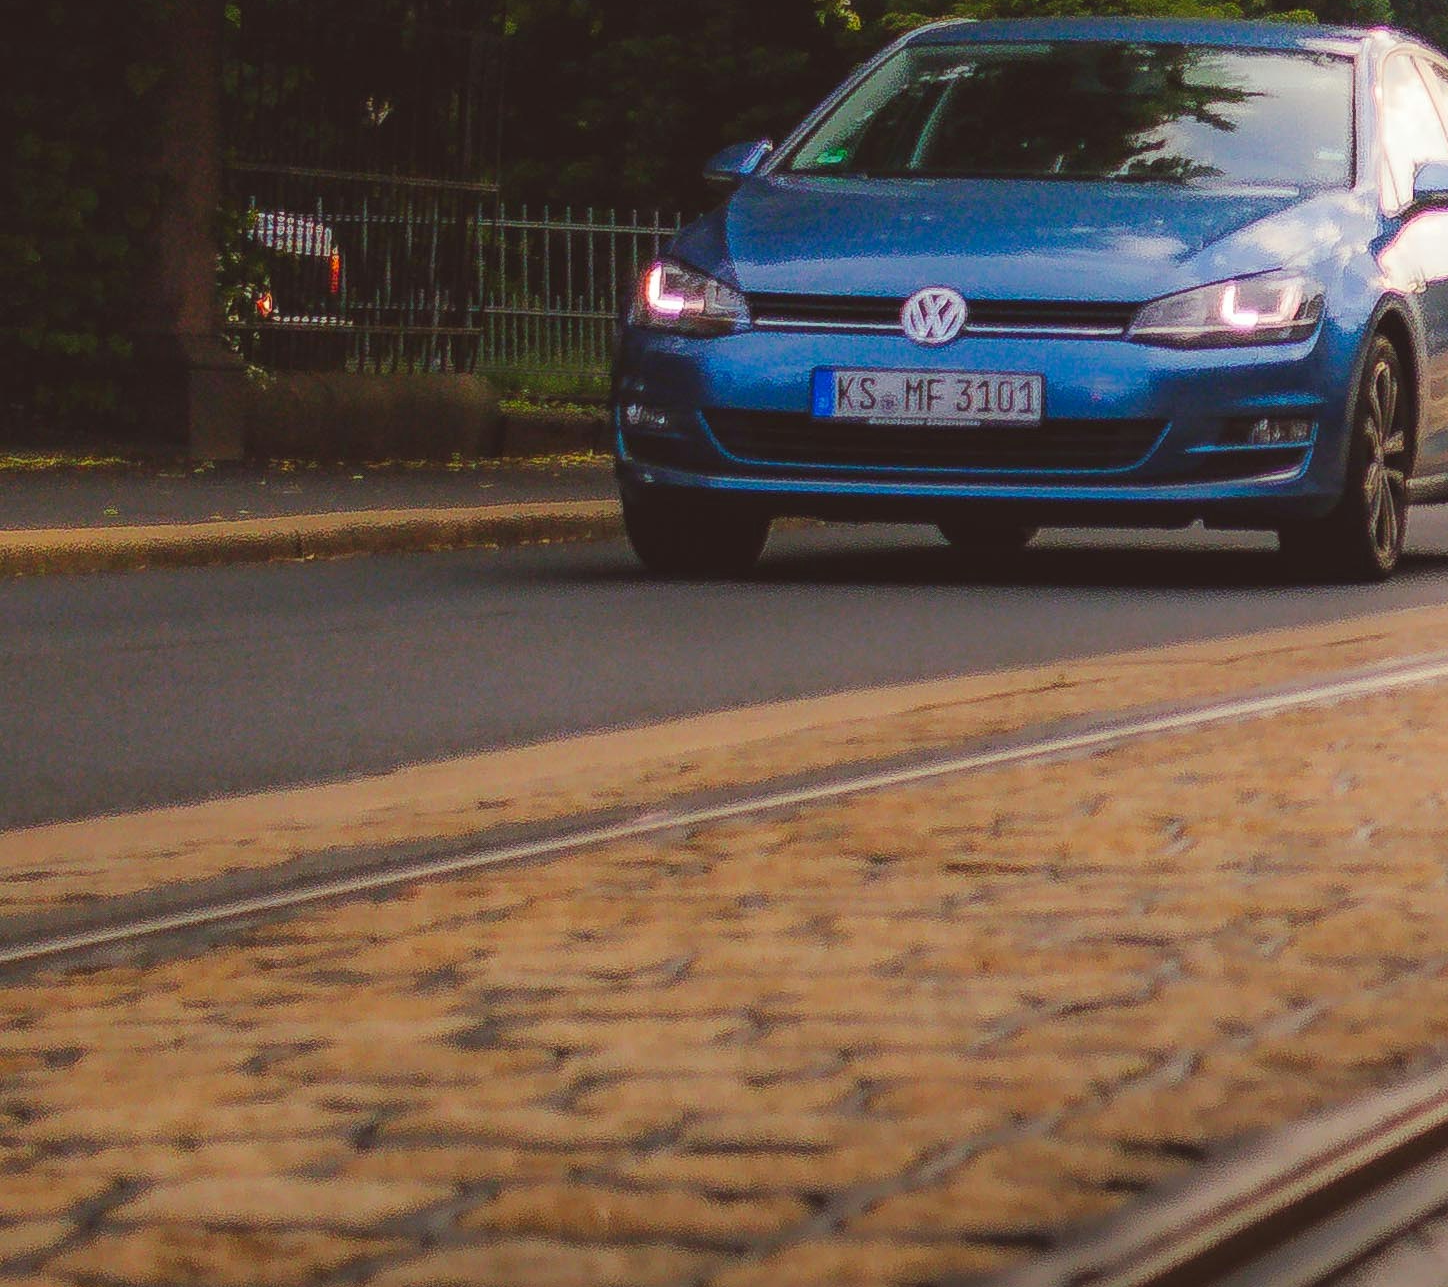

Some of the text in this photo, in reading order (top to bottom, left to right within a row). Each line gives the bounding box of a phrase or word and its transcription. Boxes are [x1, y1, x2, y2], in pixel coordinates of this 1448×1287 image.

[837, 376, 1034, 414] KS MF 3101
